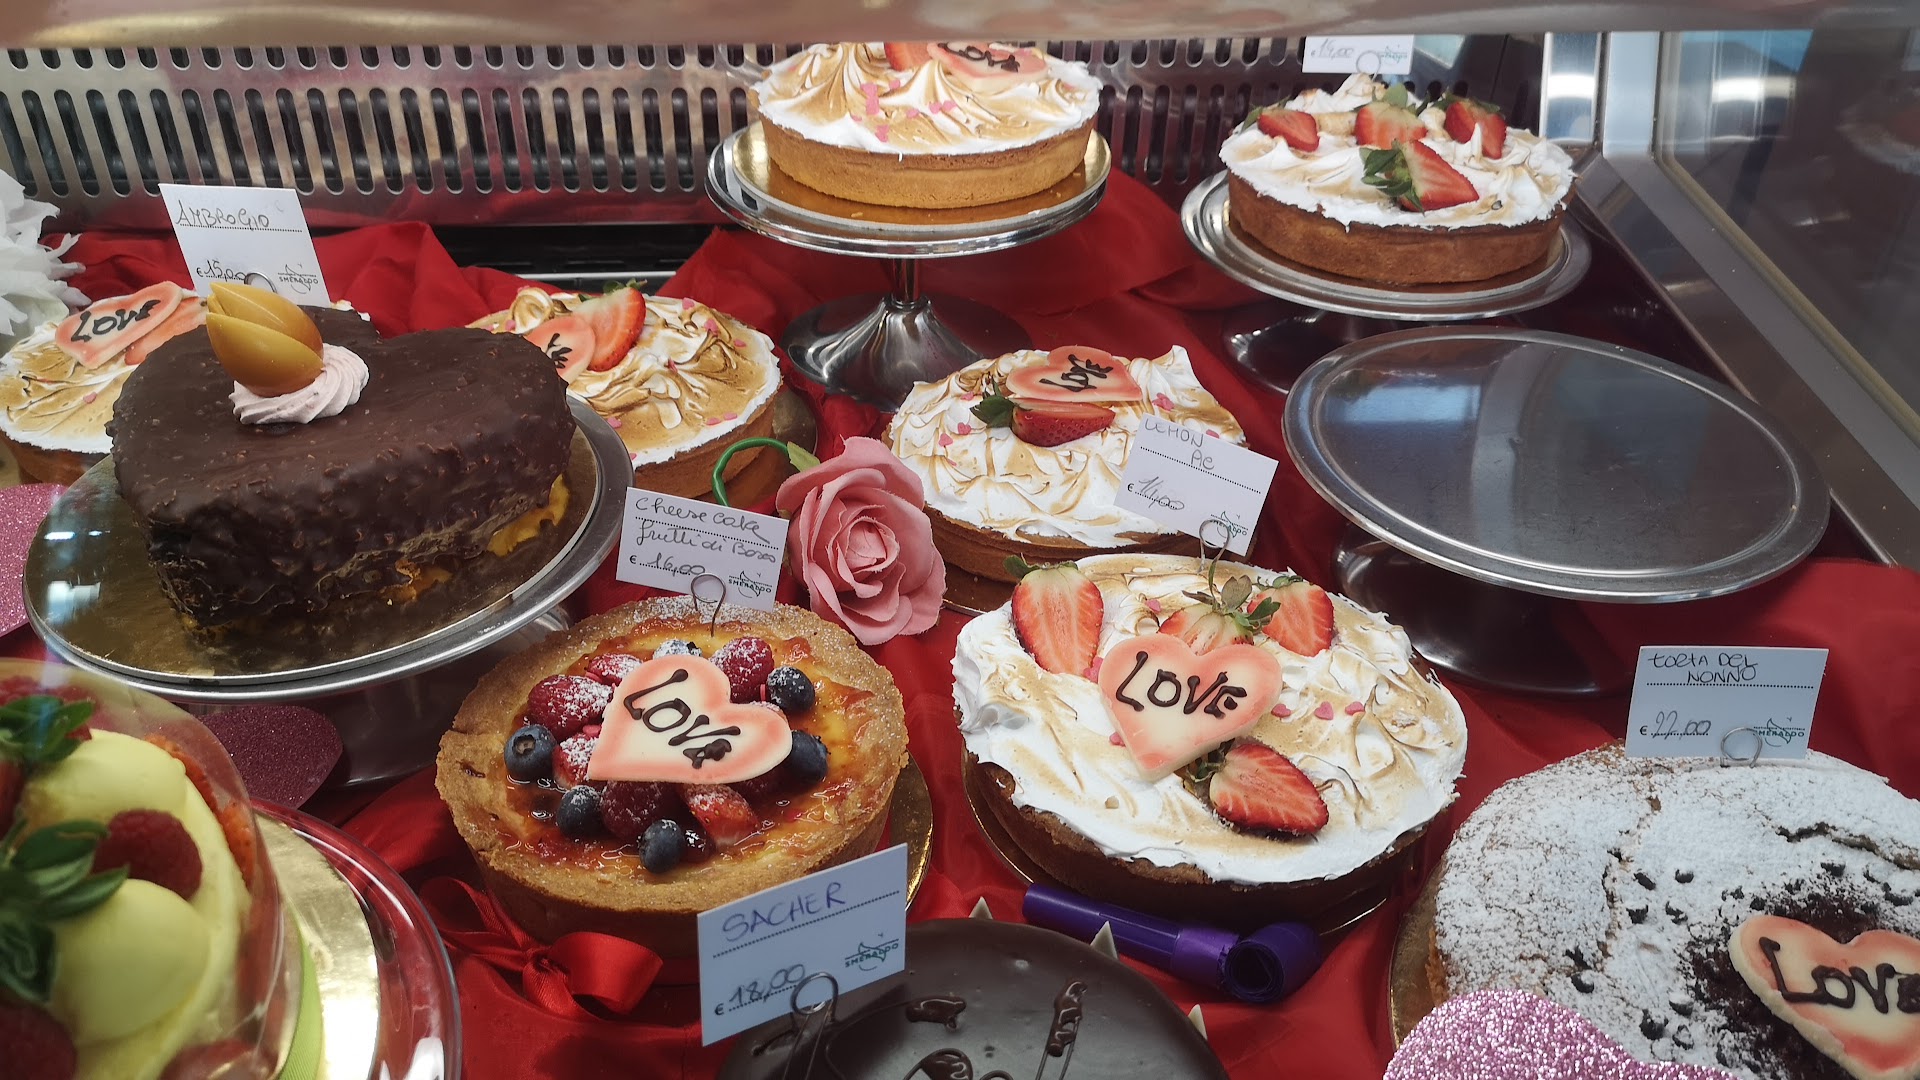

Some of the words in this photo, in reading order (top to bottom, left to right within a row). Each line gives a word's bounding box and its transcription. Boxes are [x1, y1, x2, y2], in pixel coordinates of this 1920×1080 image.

[629, 555, 637, 565] €
[1639, 725, 1648, 736] €
[722, 882, 846, 942] SACHER
[714, 1003, 725, 1016] €
